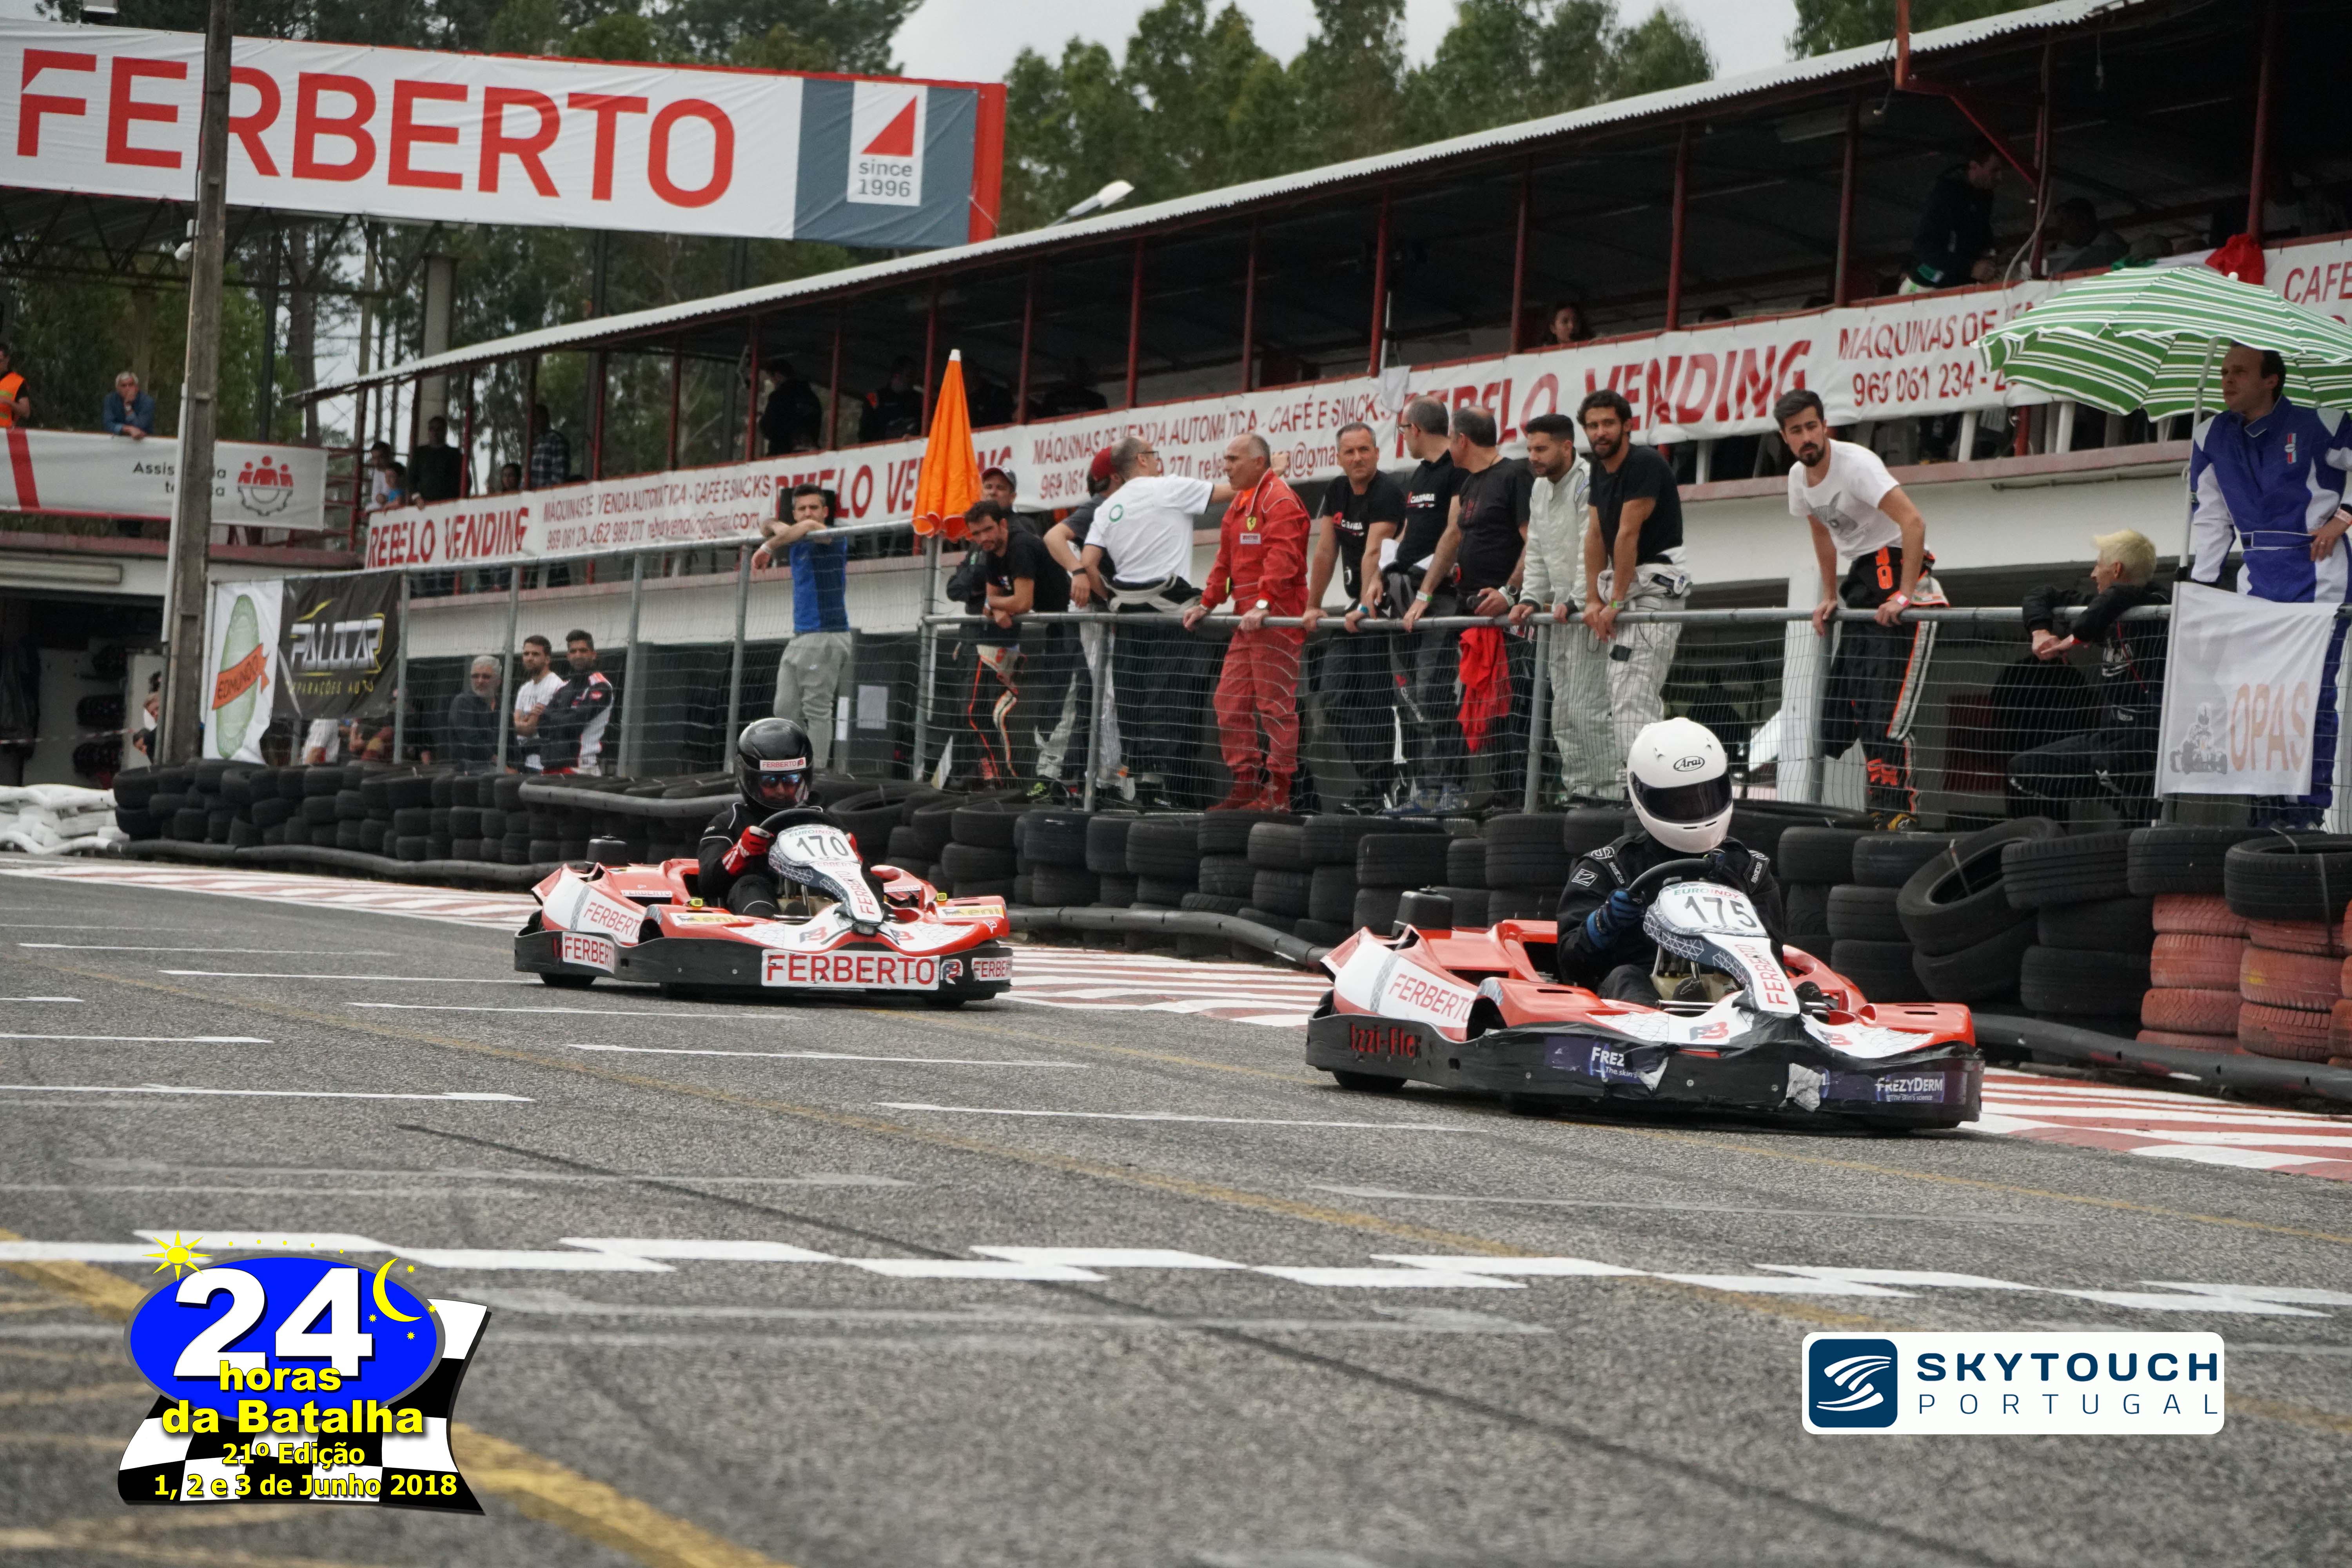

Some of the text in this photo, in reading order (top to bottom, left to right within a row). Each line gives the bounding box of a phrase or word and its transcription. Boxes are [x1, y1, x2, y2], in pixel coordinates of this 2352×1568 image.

[16, 48, 735, 209] FERBERTO
[859, 159, 913, 176] since
[858, 179, 910, 197] 1996
[1896, 366, 1929, 402] 061
[1939, 361, 1975, 398] 234
[1269, 394, 1313, 433] CAFÉ
[1318, 401, 1327, 429] E
[367, 506, 529, 568] REBELO VENDING
[1675, 757, 1701, 769] Arai
[789, 829, 836, 837] EUROINDY
[797, 835, 849, 857] 170
[835, 871, 875, 915] FERBERTO
[1674, 888, 1739, 898] EUROINDY
[968, 907, 999, 916] eni
[1684, 896, 1757, 928] 175
[565, 936, 615, 970] FERBERTO
[767, 955, 935, 985] FERBERTO
[1735, 944, 1788, 1005] FERBERTO
[1606, 1066, 1618, 1074] The
